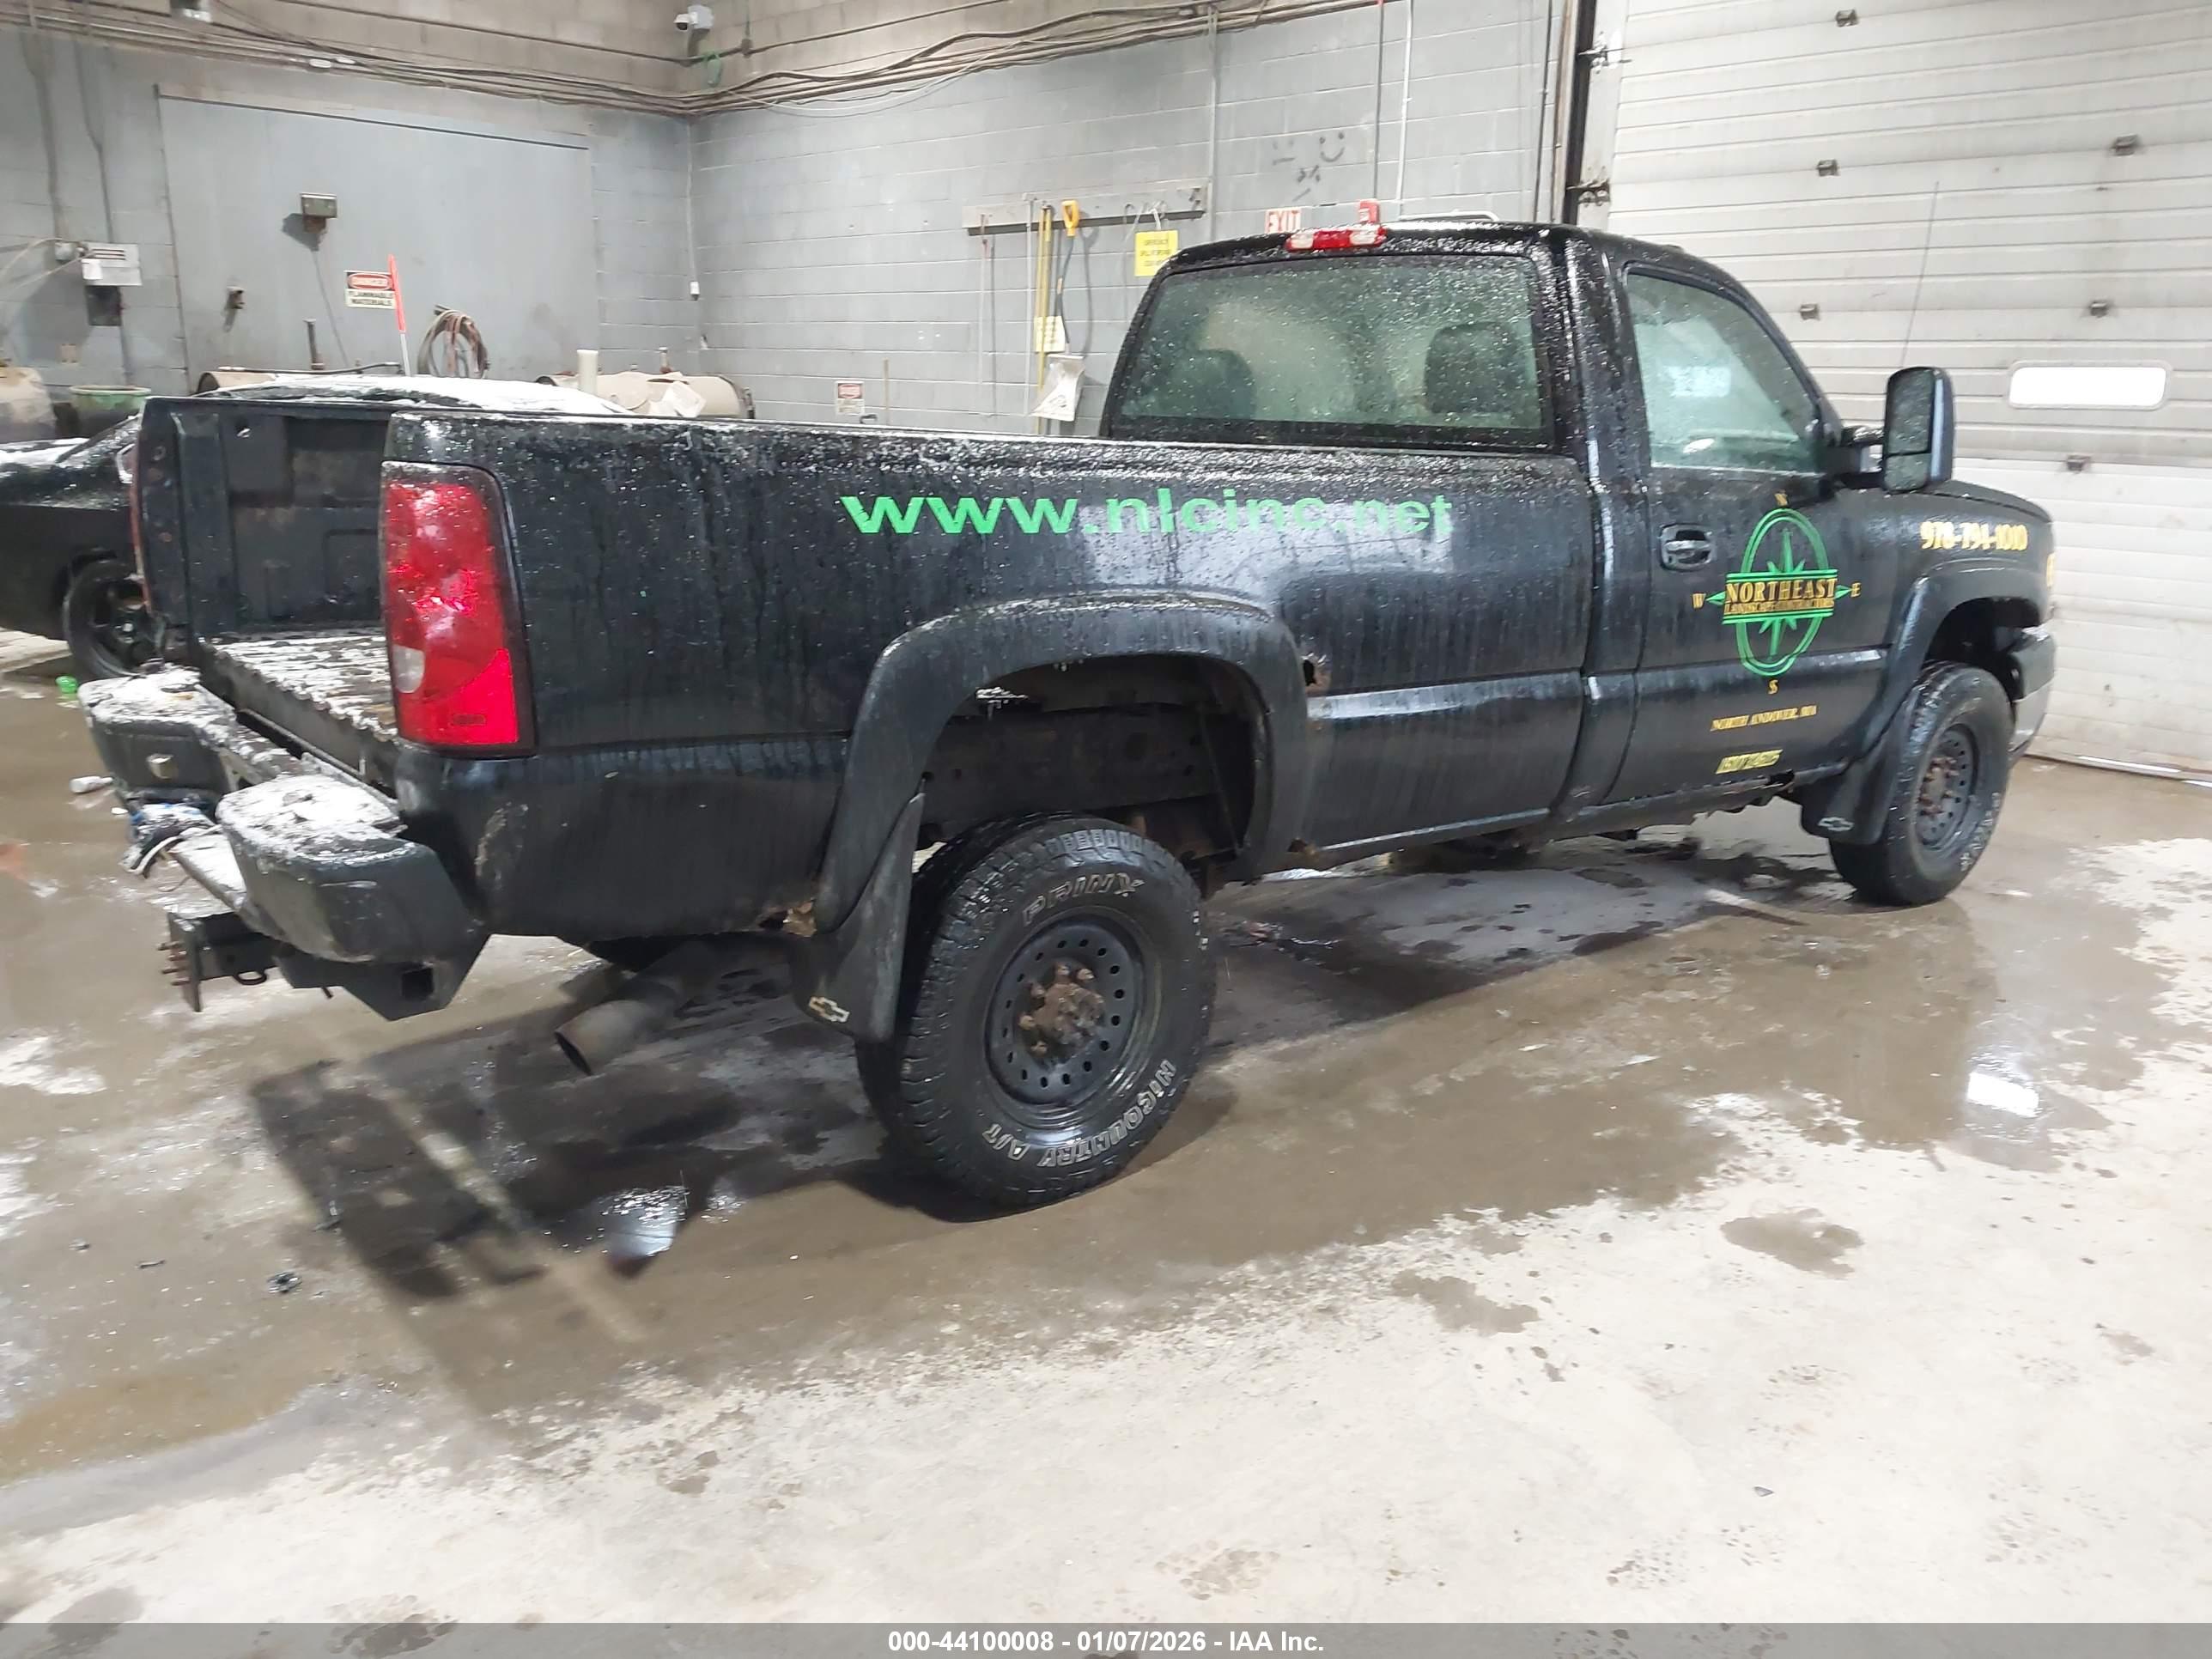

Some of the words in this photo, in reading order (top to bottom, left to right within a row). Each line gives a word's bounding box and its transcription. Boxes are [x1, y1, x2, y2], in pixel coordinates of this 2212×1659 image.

[1266, 210, 1301, 233] EXIT
[840, 488, 1453, 535] www.nlcinc.net
[1692, 592, 1707, 610] W
[1725, 578, 1838, 604] NORTHEAST
[1850, 581, 1862, 598] E
[1767, 678, 1779, 695] S
[1022, 872, 1146, 927] PRINX
